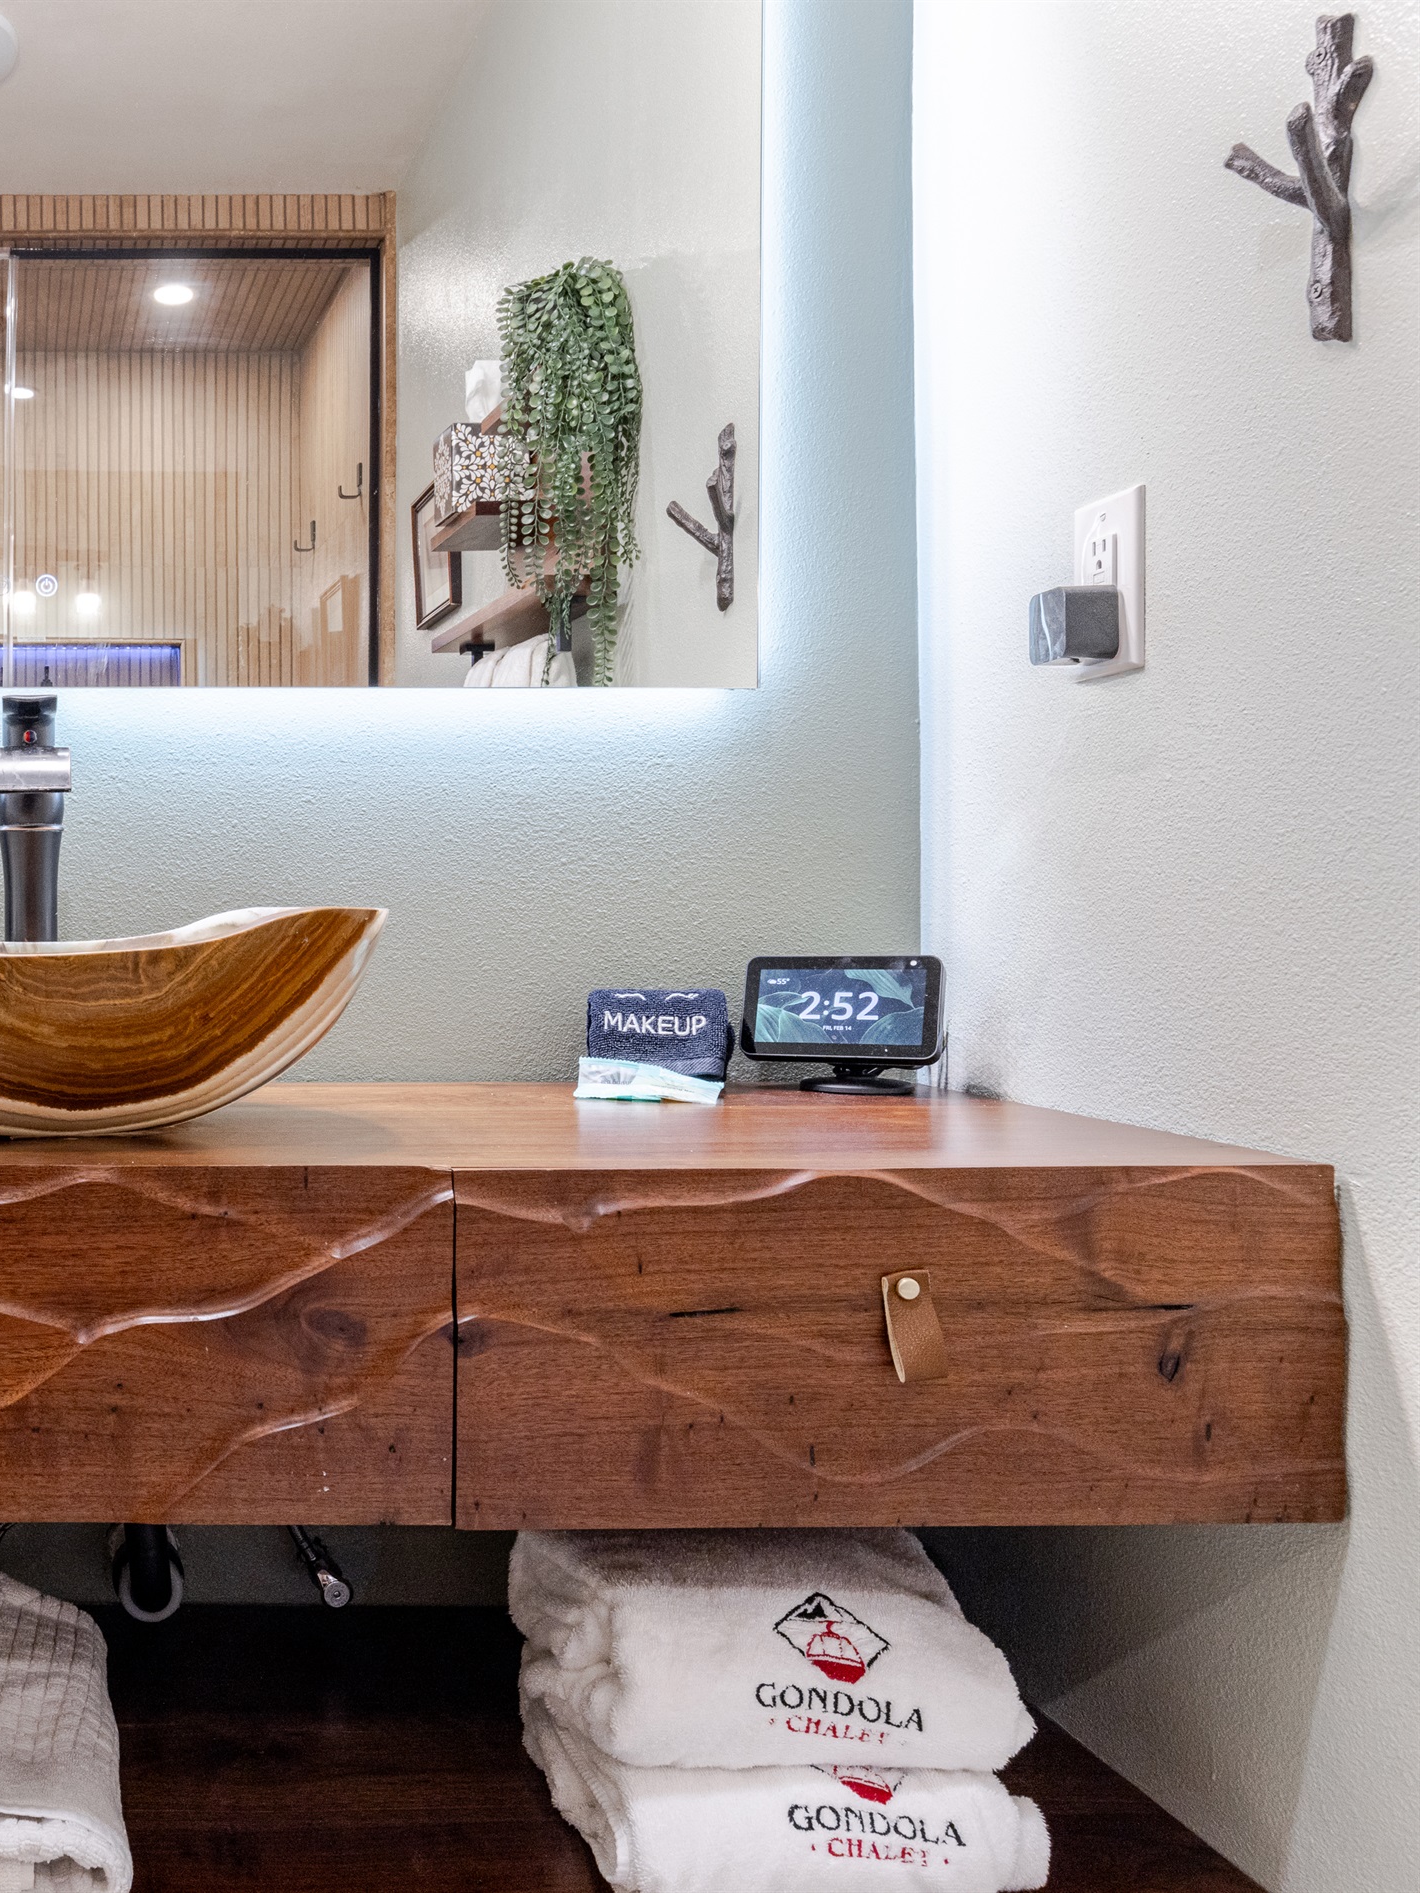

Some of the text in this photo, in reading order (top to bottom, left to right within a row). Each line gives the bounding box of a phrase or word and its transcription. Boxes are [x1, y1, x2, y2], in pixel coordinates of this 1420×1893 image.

[799, 991, 879, 1021] 2:52
[604, 1010, 707, 1037] MAKEUP
[755, 1682, 923, 1732] GONDOLA
[786, 1714, 890, 1744] CHALET
[788, 1804, 967, 1847] GONDOLA
[827, 1837, 930, 1867] CHALET
